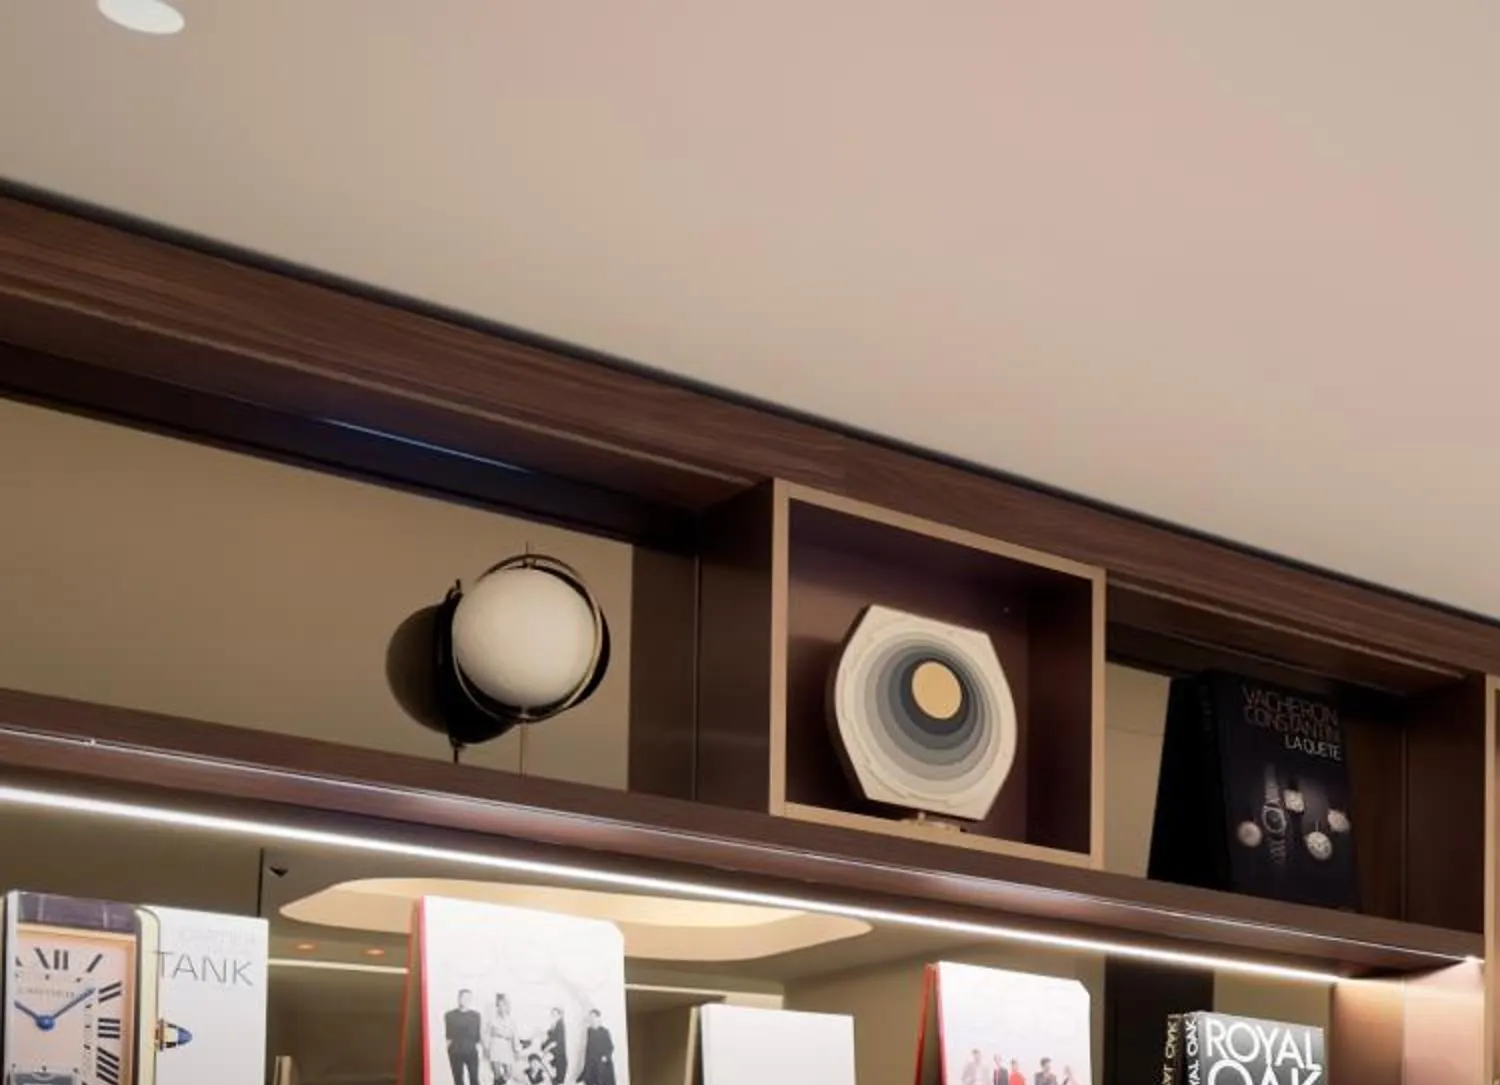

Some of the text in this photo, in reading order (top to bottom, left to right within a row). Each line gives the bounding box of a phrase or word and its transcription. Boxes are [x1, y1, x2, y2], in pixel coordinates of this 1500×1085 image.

[153, 950, 255, 987] TANK
[1185, 1017, 1199, 1057] OAK
[1205, 1016, 1322, 1071] ROYAL
